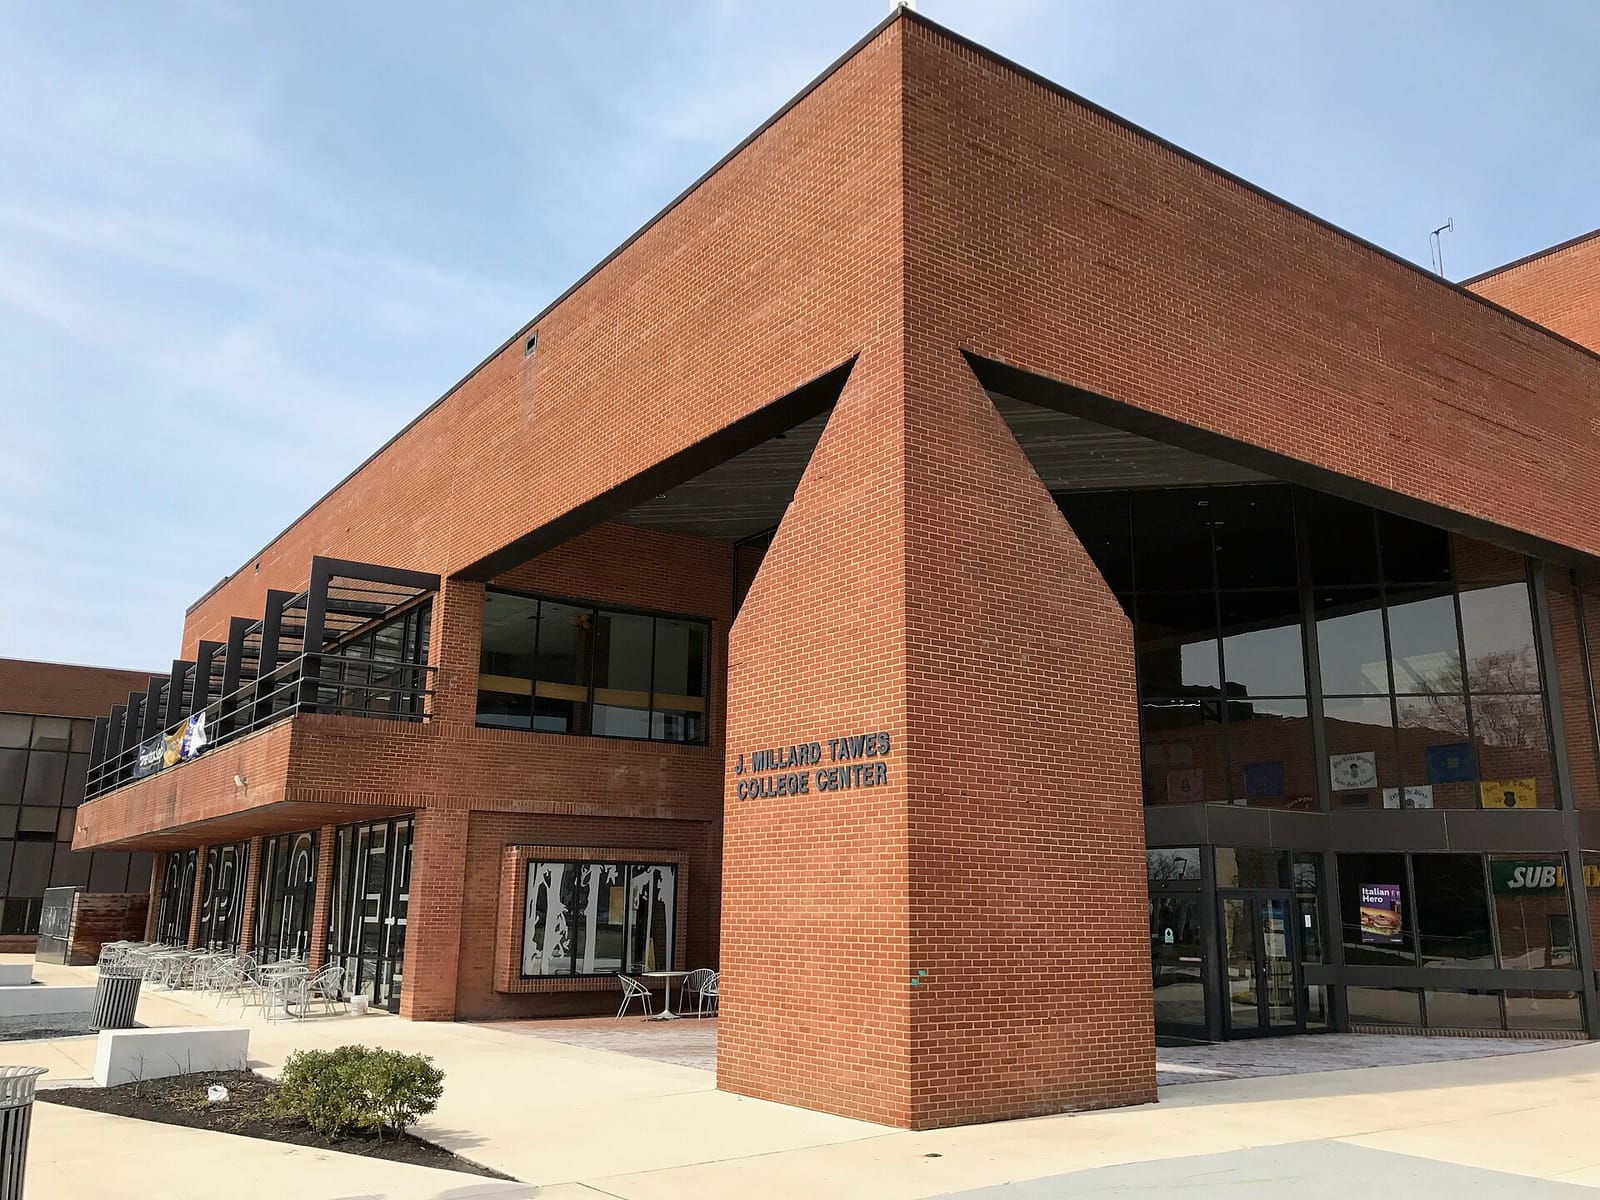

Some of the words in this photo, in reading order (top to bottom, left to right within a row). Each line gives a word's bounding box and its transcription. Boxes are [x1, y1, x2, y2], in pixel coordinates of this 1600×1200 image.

[735, 754, 747, 775] J.
[752, 742, 821, 772] MILLARD
[828, 731, 890, 761] TAWES
[737, 771, 809, 800] COLLEGE
[815, 762, 887, 791] CENTER
[1362, 887, 1390, 896] Italian
[1362, 895, 1384, 903] Hero
